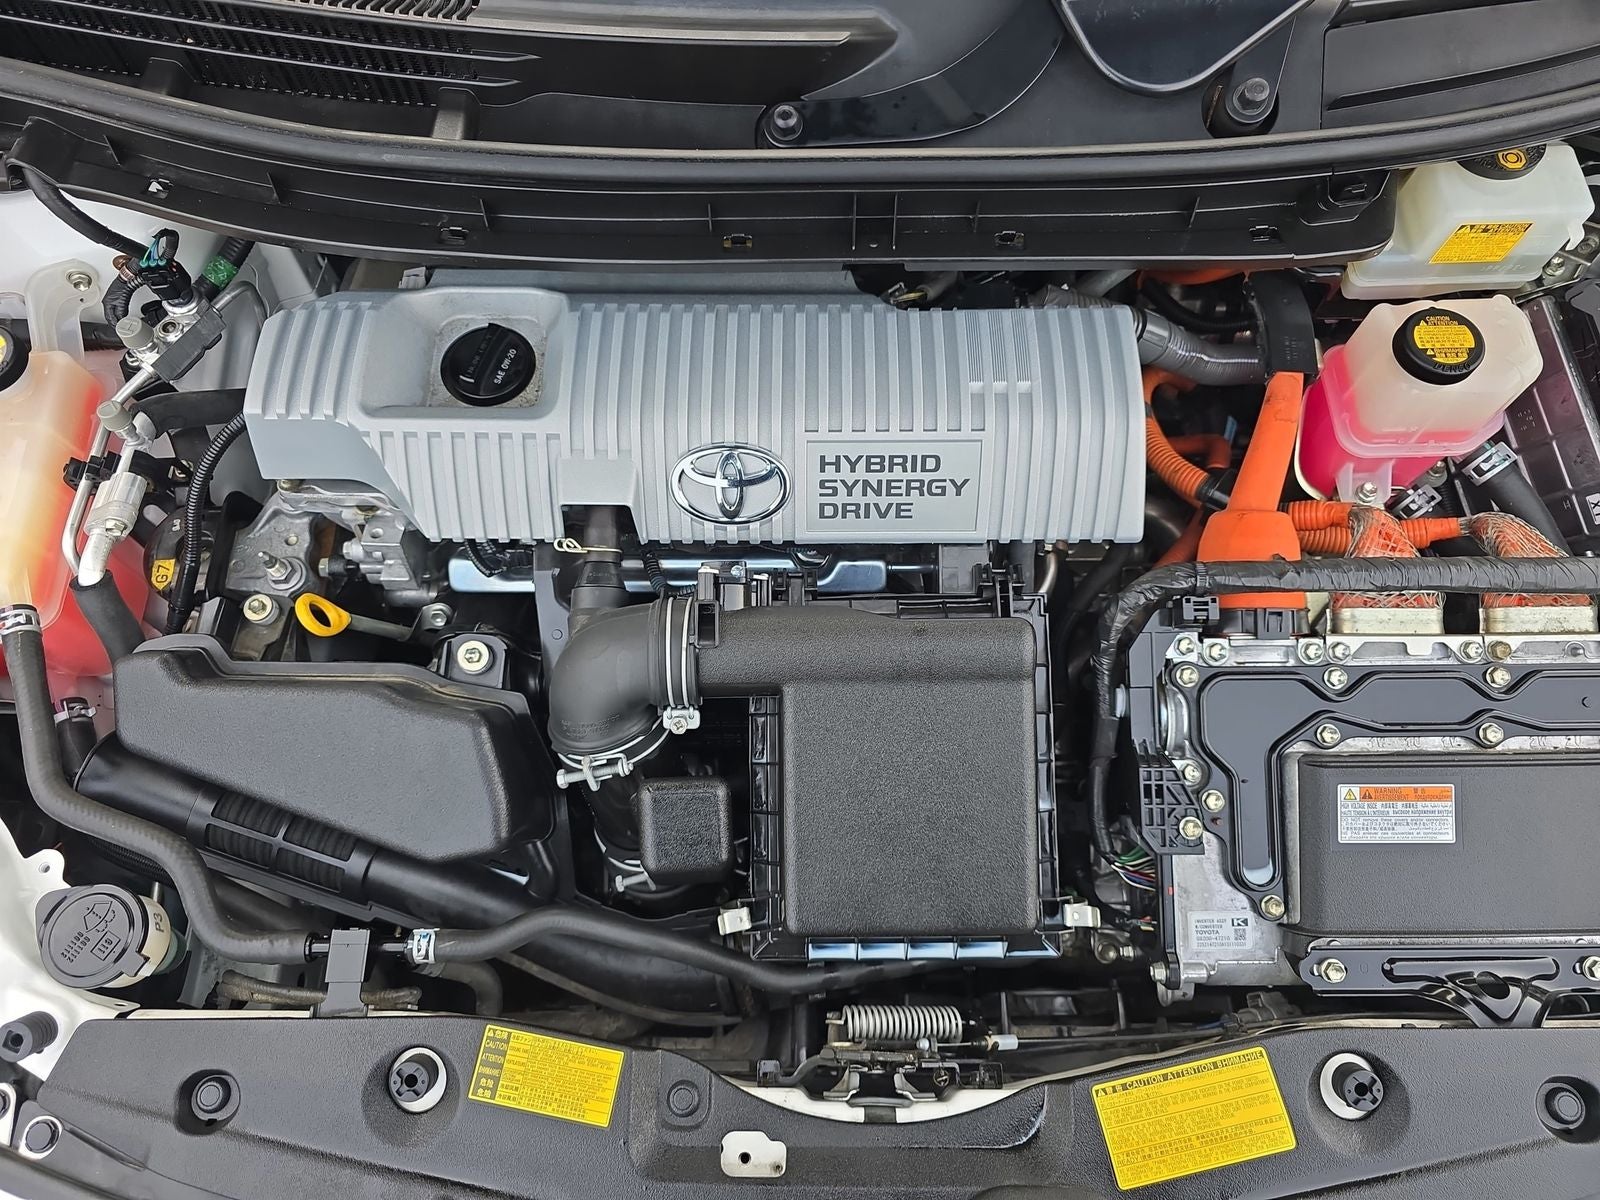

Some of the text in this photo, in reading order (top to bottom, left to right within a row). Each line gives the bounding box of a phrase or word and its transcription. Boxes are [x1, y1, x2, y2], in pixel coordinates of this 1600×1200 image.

[494, 370, 506, 384] SAE
[818, 454, 942, 474] HYBRID
[818, 478, 971, 497] SYNERGY
[818, 502, 914, 520] DRIVE
[155, 564, 170, 584] G7
[153, 912, 164, 933] P3
[485, 1039, 508, 1050] CAUTION
[482, 1053, 504, 1063] ATTENTION
[1126, 1074, 1163, 1089] CAUTION
[1167, 1063, 1214, 1080] ATTENTION
[1217, 1052, 1264, 1068] ВНИМАНИЕ
